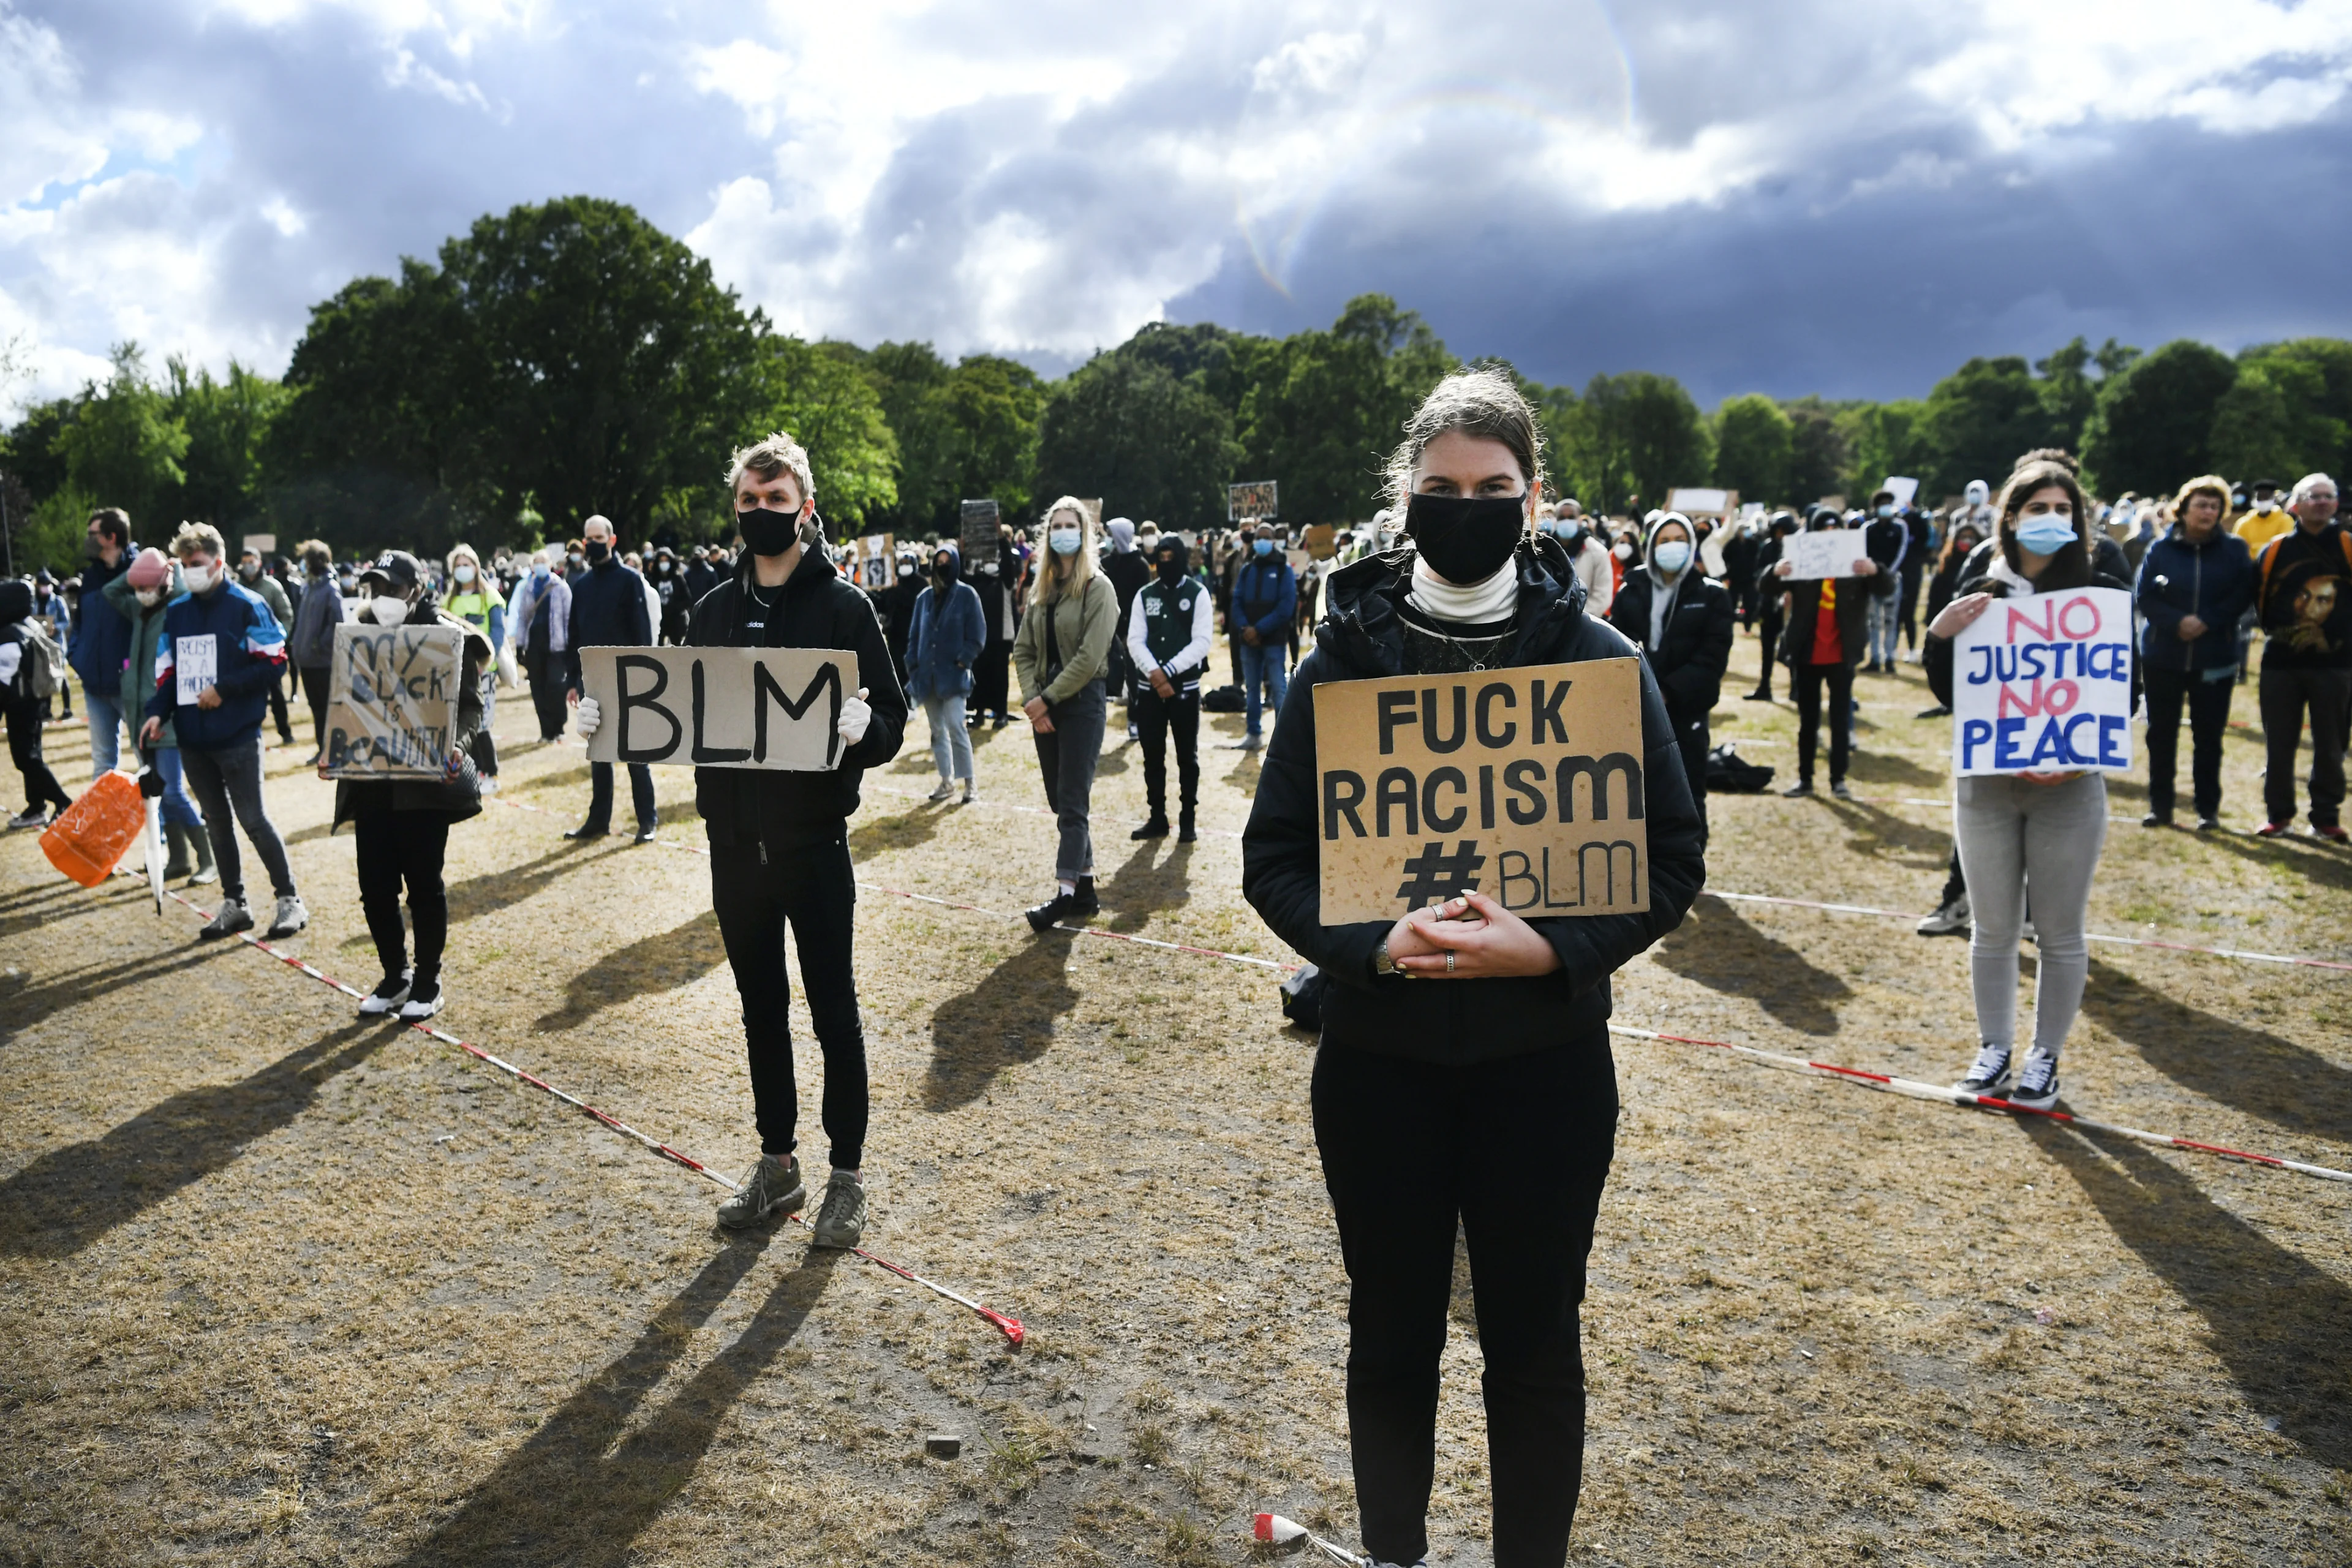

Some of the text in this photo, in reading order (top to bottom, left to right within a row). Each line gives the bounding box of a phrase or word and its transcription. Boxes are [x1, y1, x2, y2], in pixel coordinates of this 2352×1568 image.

[2007, 596, 2102, 644] NO
[179, 658, 208, 674] IS A
[348, 631, 428, 677] MY
[1967, 642, 2130, 685] JUSTICE
[352, 666, 451, 703] BLACK
[1998, 677, 2081, 719] NO
[616, 654, 842, 767] BLM
[1378, 679, 1572, 755] FUCK
[1963, 713, 2128, 769] PEACE
[1323, 752, 1645, 840] RACISM
